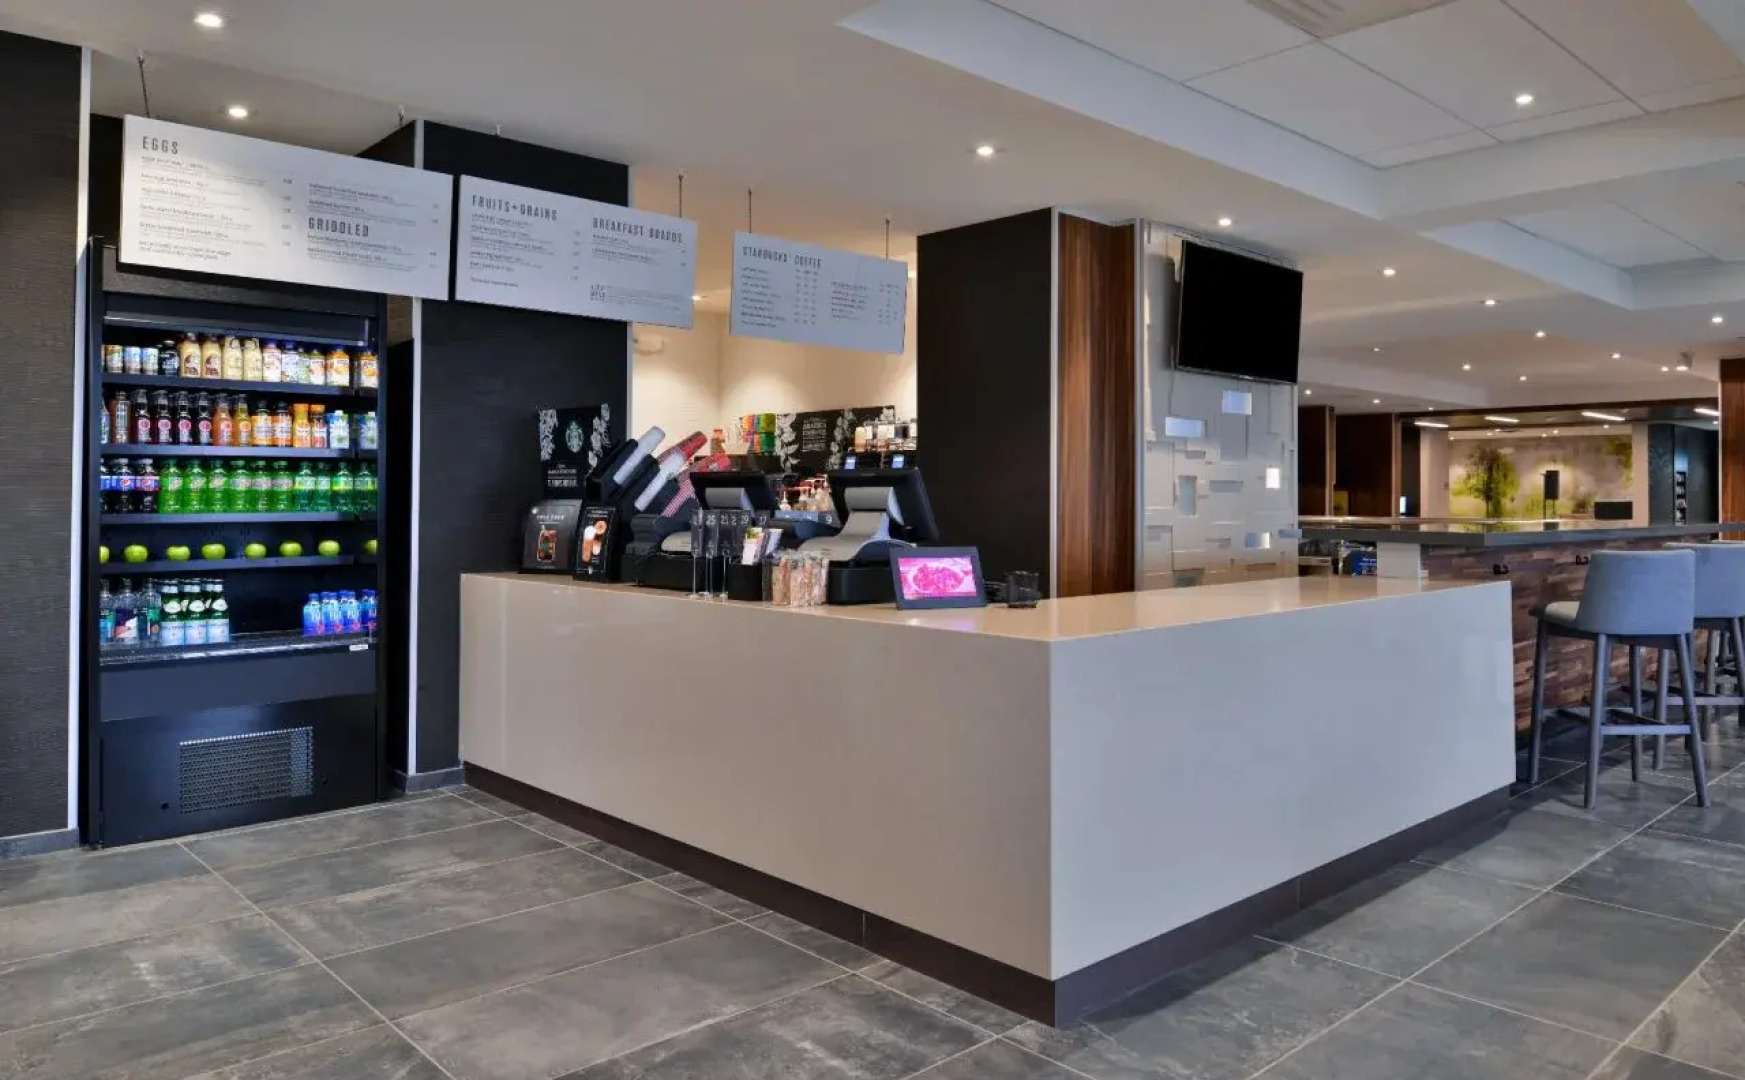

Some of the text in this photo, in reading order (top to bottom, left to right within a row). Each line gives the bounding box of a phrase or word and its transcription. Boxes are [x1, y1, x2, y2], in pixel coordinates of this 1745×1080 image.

[142, 135, 179, 155] EGGS
[308, 216, 369, 237] GRIDDLED
[592, 217, 684, 244] BREAKFAST BOARDS
